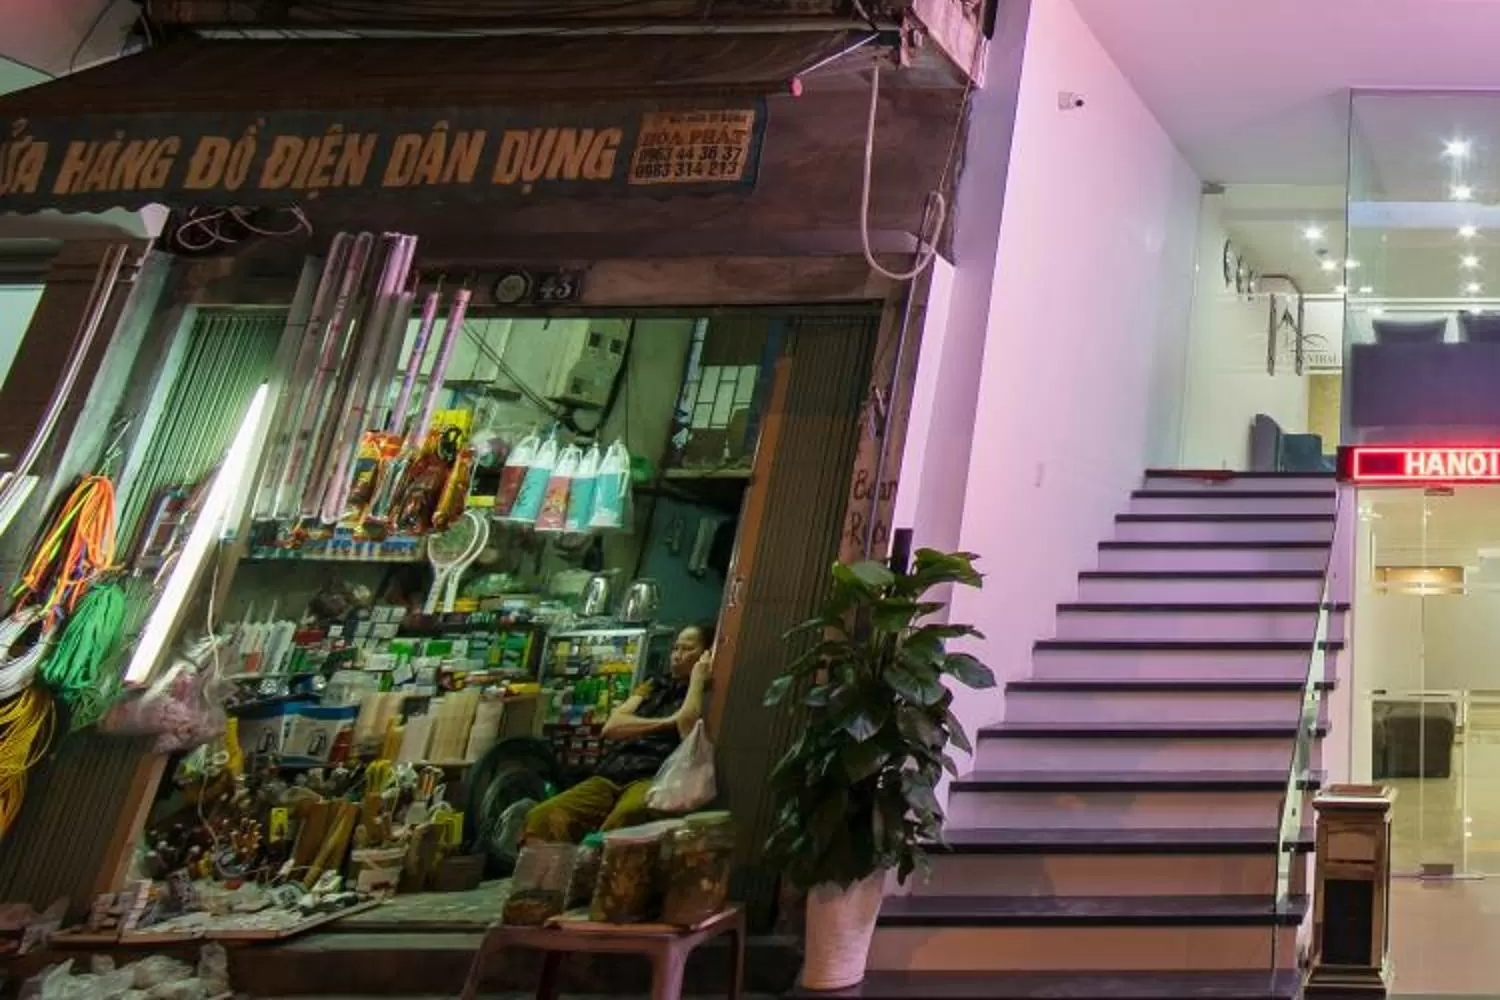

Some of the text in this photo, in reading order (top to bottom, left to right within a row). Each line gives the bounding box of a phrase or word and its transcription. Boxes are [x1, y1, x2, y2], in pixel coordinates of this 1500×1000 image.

[52, 128, 181, 195] HÀNG
[182, 116, 267, 191] ĐỒ
[259, 122, 380, 200] ĐIỆN
[382, 118, 489, 188] DÂN
[492, 127, 626, 195] DỤNG
[1404, 450, 1498, 477] HANOI
